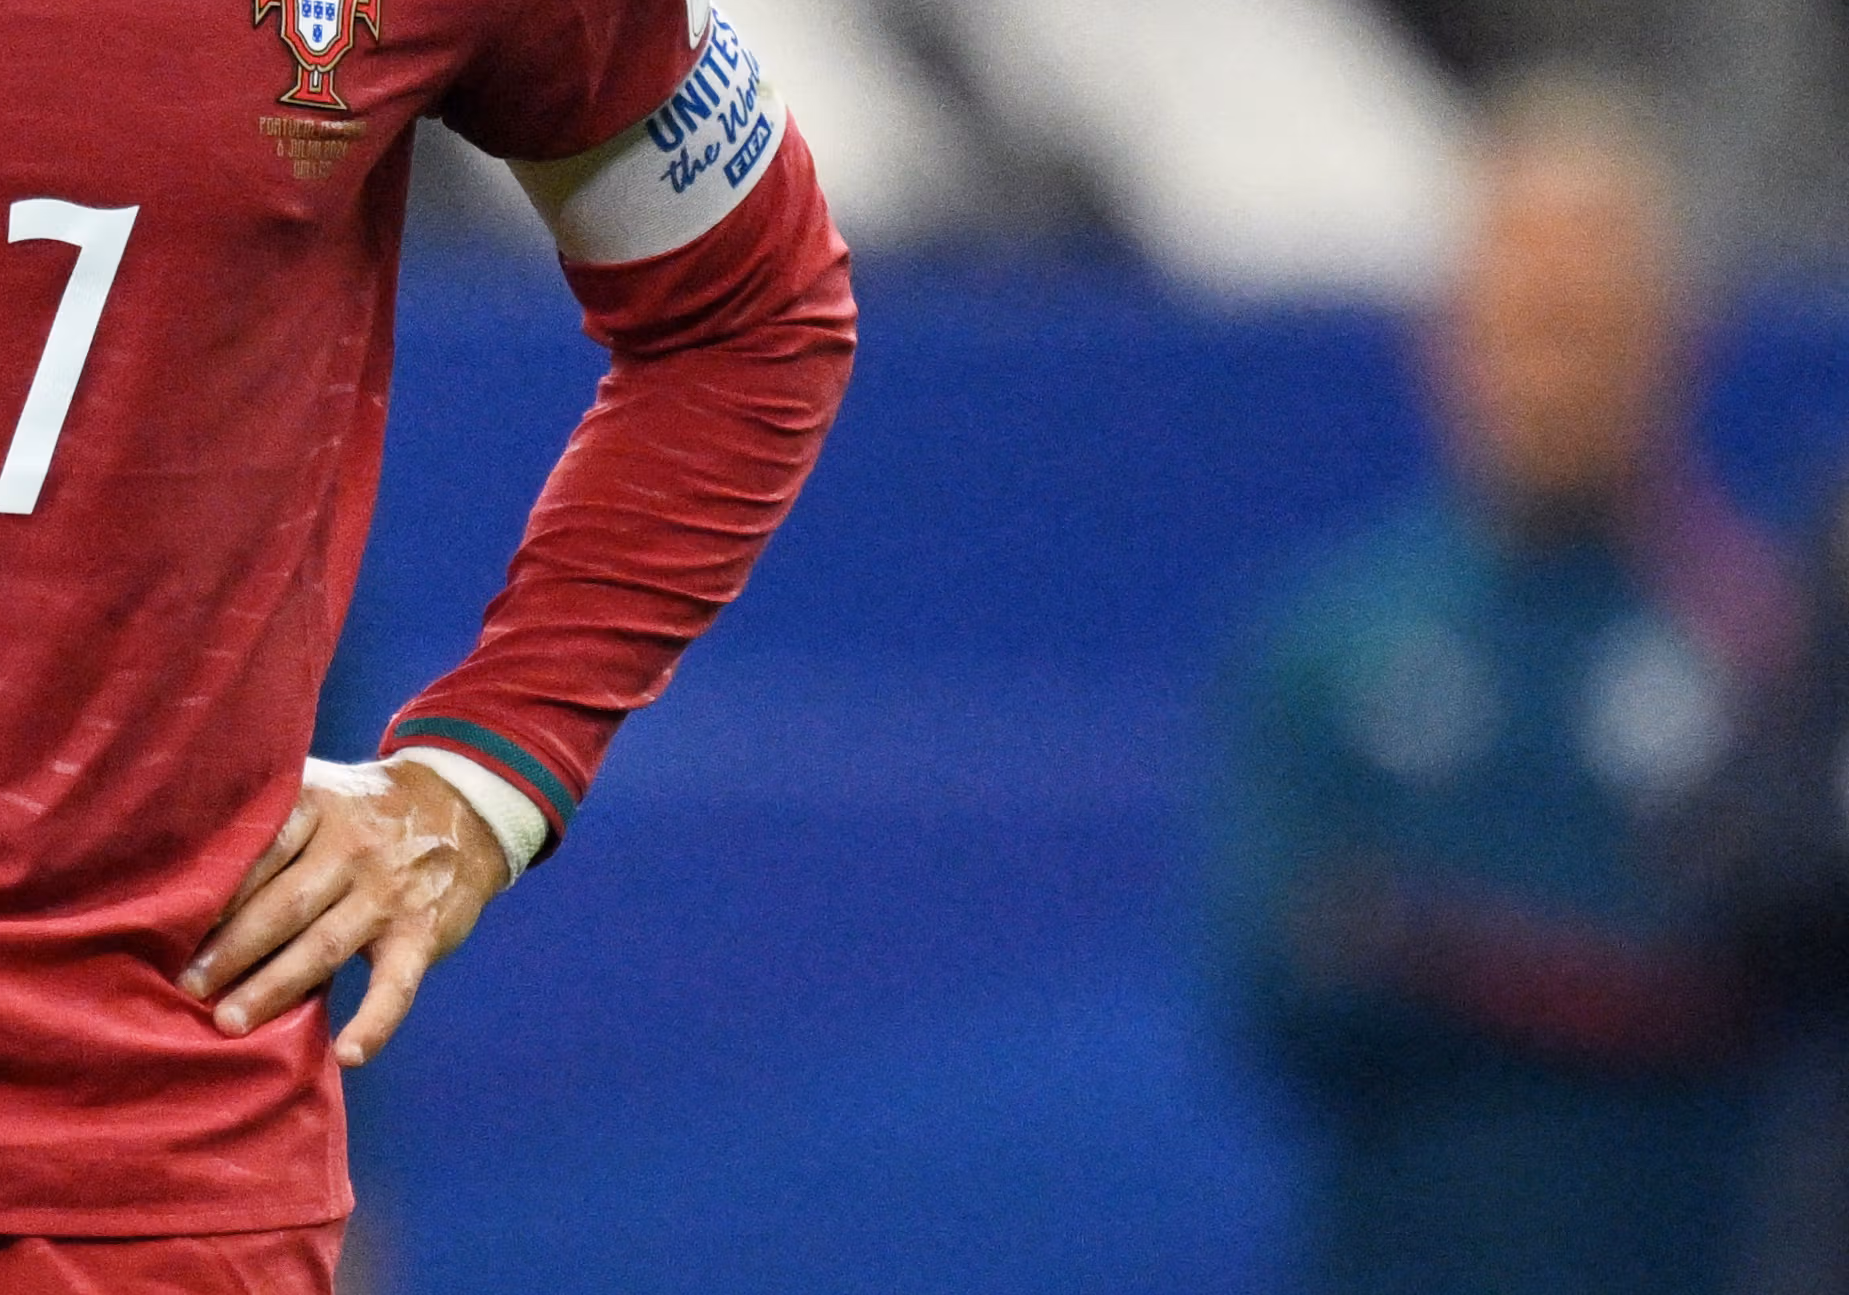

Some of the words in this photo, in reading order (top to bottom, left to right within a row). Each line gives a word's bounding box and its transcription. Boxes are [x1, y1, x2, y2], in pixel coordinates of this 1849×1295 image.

[645, 7, 739, 153] UNITES
[660, 143, 721, 193] the
[727, 121, 771, 182] FIFA
